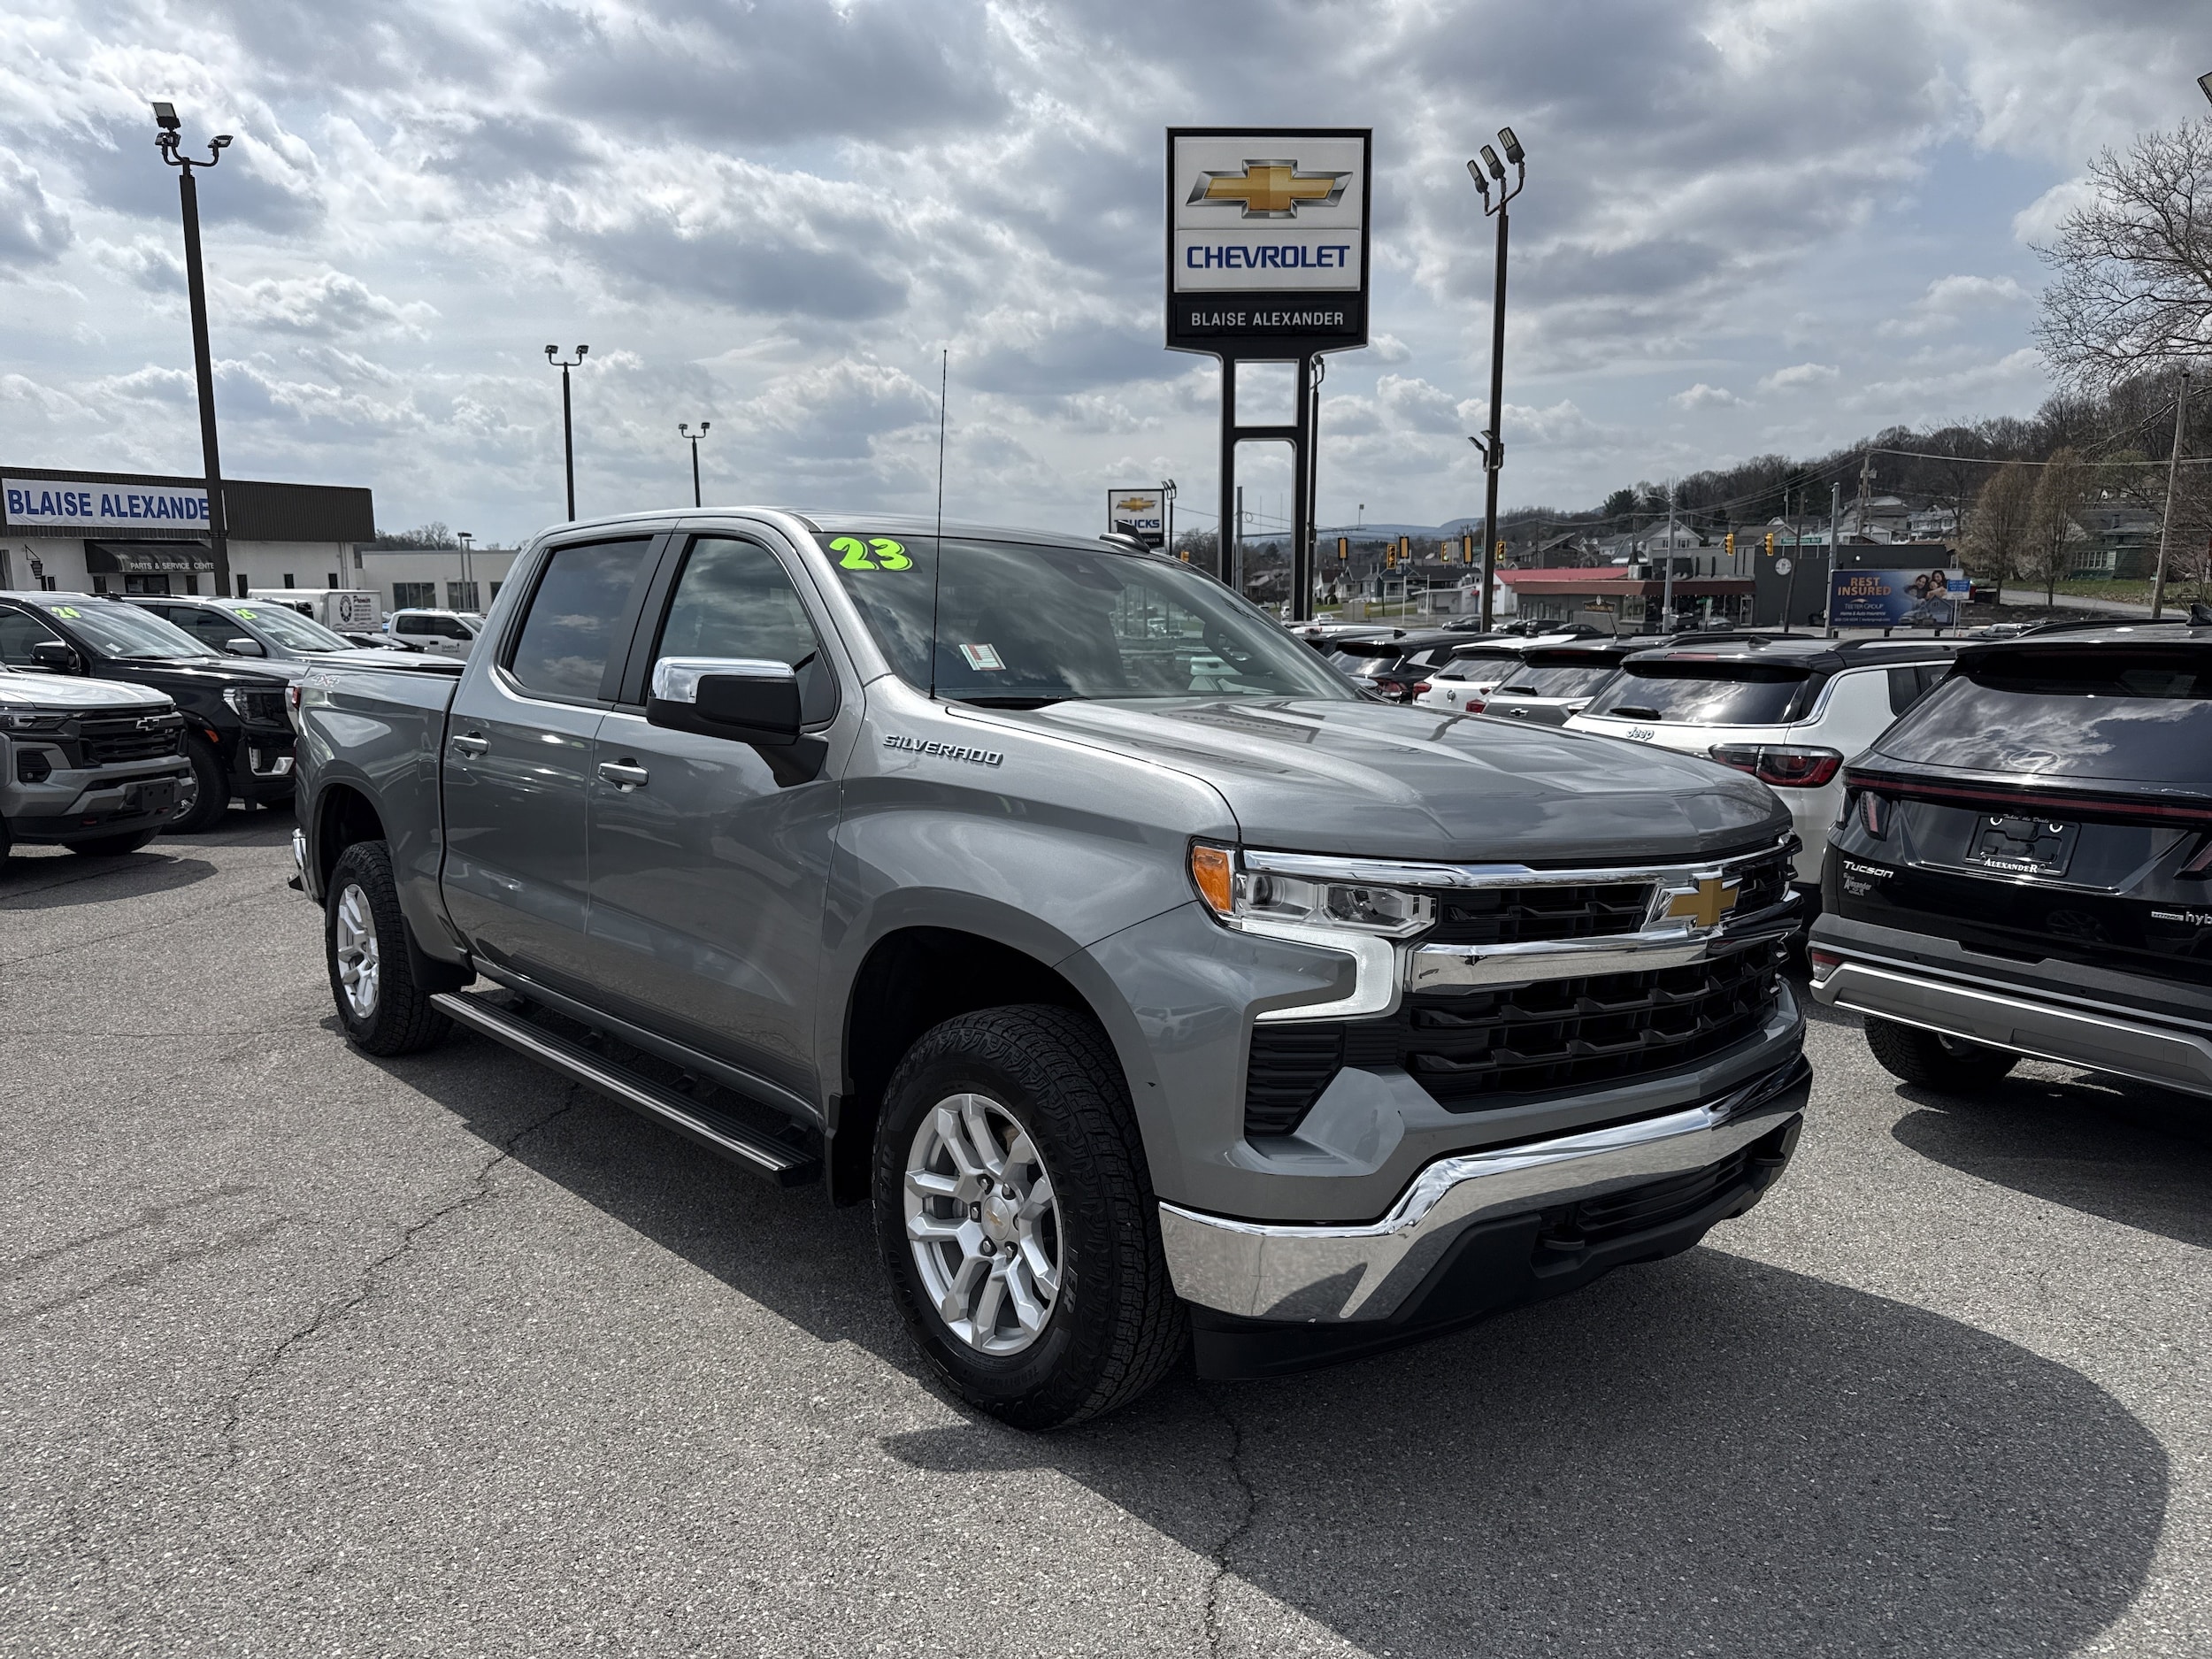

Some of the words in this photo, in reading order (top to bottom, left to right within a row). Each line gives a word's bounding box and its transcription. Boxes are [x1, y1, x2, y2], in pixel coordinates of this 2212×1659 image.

[1187, 245, 1350, 269] CHEVROLET
[1191, 312, 1247, 326] BLAISE
[1252, 311, 1344, 326] ALEXANDER
[7, 489, 93, 517] BLAISE
[100, 494, 210, 520] ALEXANDE
[829, 536, 913, 572] 23
[1850, 577, 1880, 587] REST
[1838, 586, 1892, 595] INSURED
[1626, 726, 1655, 741] Jeep
[883, 734, 1003, 765] SILVERADO
[2185, 911, 2212, 926] hyb
